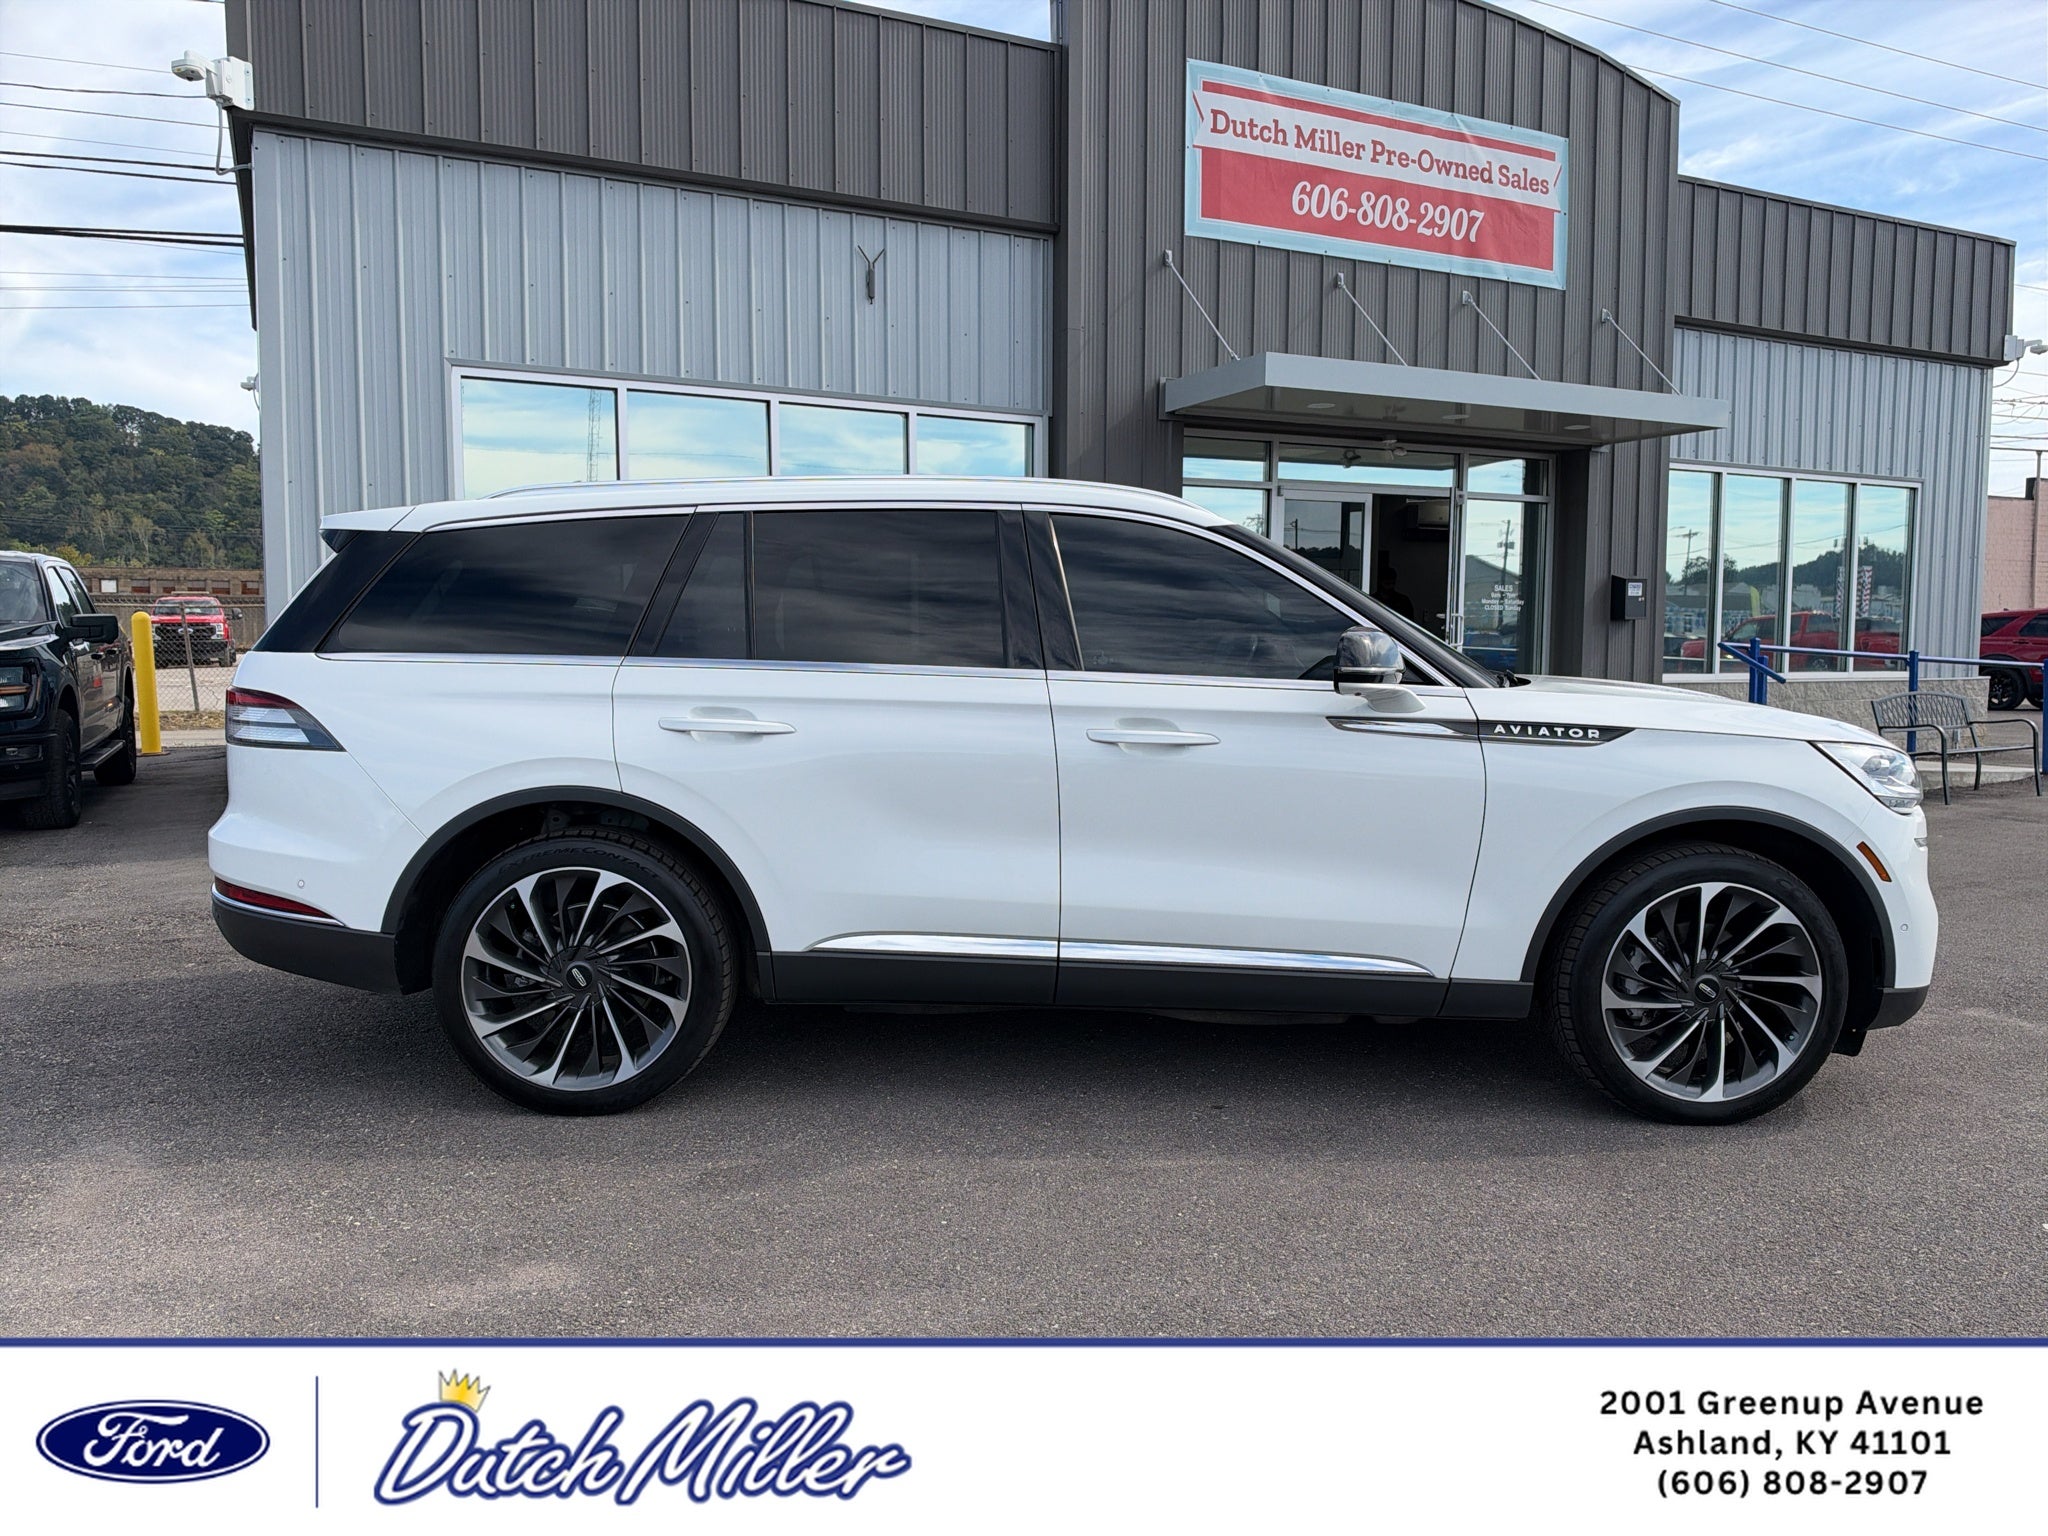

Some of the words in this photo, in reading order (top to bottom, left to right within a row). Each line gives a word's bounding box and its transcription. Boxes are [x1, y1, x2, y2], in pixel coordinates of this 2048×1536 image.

[1210, 108, 1288, 146] Dutch
[1294, 124, 1366, 161] Miller
[1371, 139, 1494, 185] Pre-Owned
[1498, 165, 1550, 195] Sales
[1291, 180, 1485, 243] 606-808-2907
[1493, 724, 1600, 739] AVIATOR
